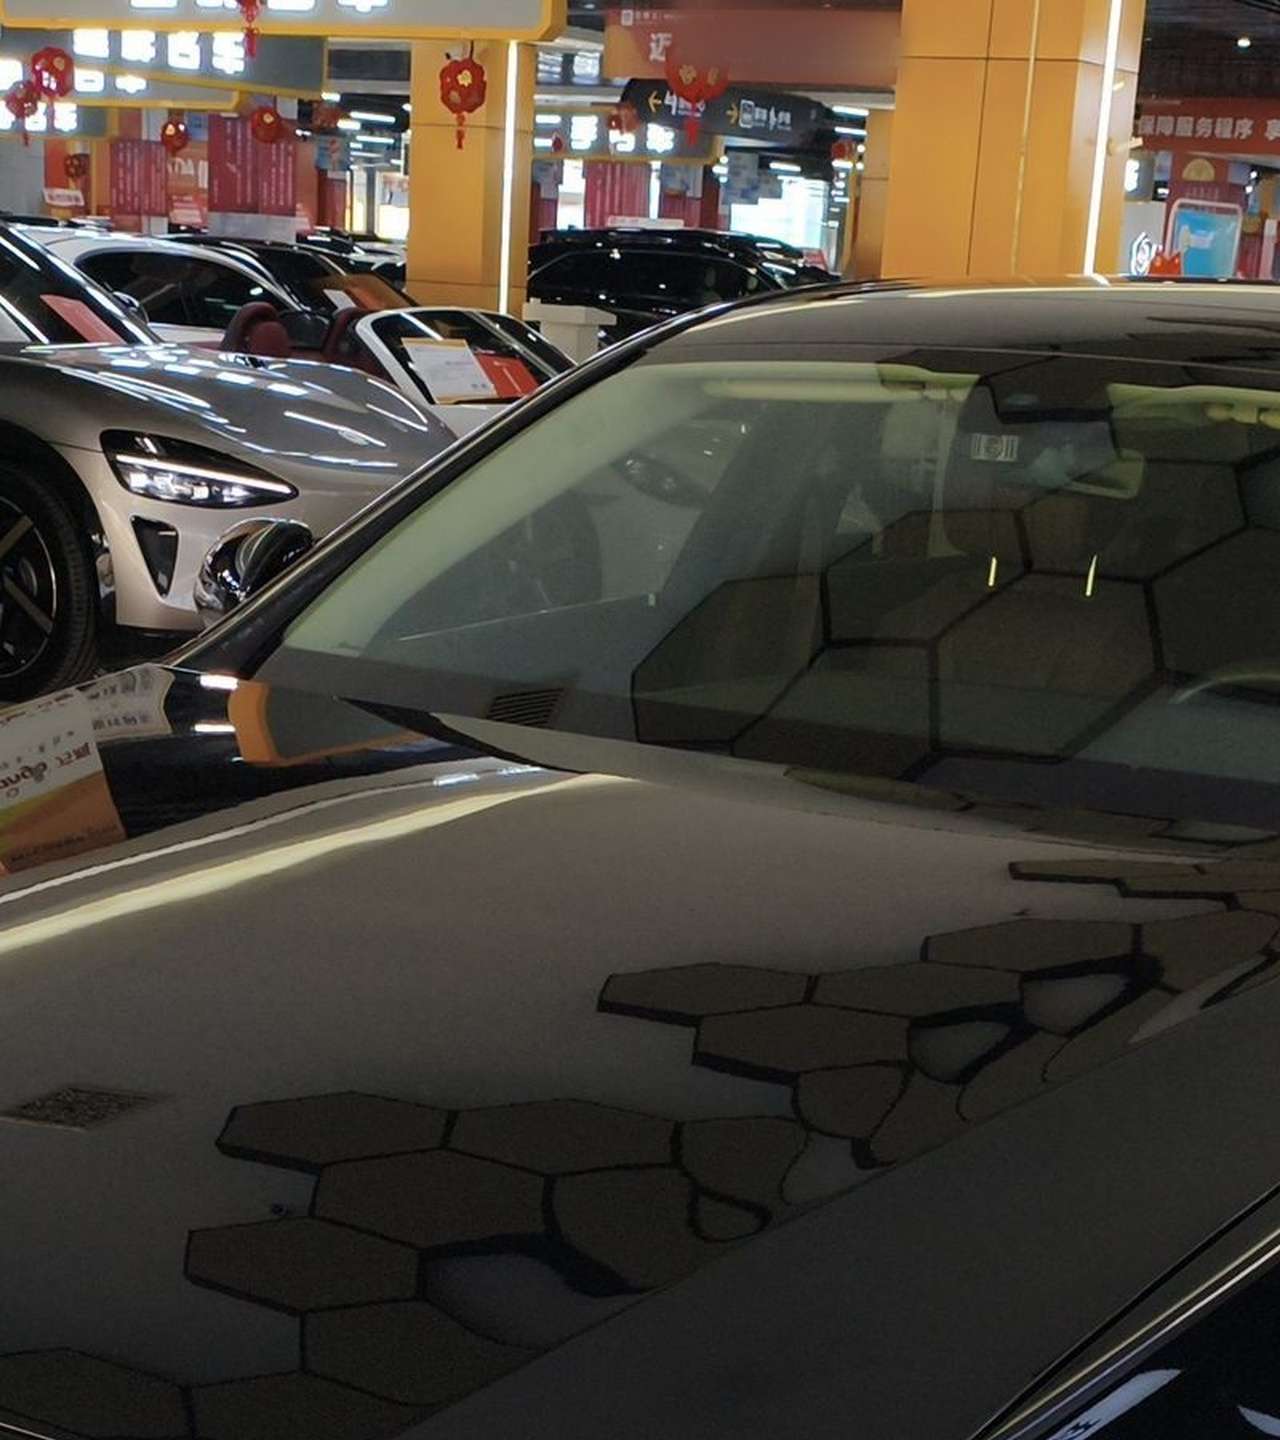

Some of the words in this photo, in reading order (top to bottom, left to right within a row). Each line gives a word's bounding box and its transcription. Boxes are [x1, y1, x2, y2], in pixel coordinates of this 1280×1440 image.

[1138, 115, 1254, 139] 保障服务程序
